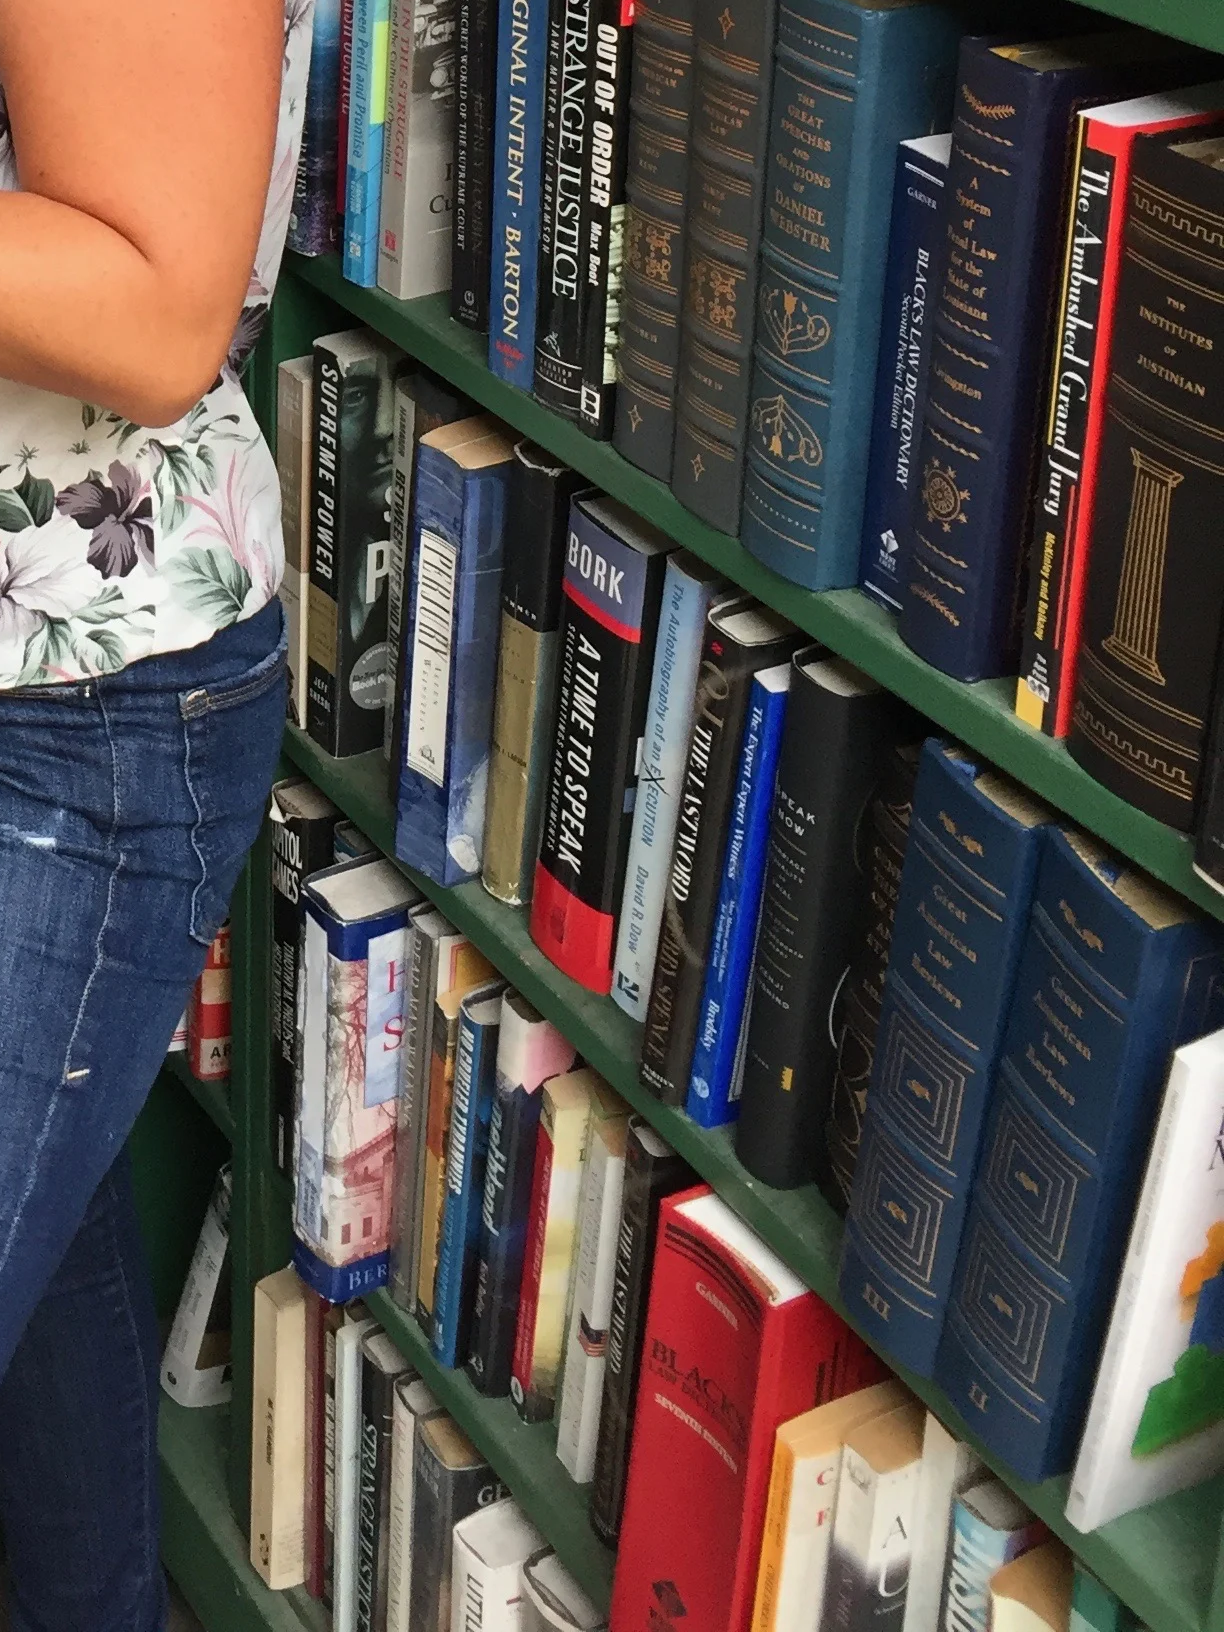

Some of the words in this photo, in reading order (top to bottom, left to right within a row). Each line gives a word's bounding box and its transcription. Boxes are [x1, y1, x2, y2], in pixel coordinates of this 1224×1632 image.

[596, 23, 619, 75] OUT
[594, 76, 616, 116] OF
[506, 94, 525, 207] INTENT
[589, 121, 613, 208] ORDER
[1077, 165, 1111, 213] The
[552, 156, 583, 301] JUSTICE
[499, 224, 522, 340] BARTON
[910, 247, 930, 327] BLACK'S
[1062, 223, 1103, 367] Ambushed
[906, 329, 923, 374] LAW
[319, 363, 339, 487] SUPREME
[895, 374, 920, 489] DICTIONARY
[1054, 370, 1087, 460] Grand
[1043, 455, 1078, 518] Jury
[316, 490, 336, 580] POWER
[568, 532, 625, 605] BORK
[579, 633, 599, 660] A
[575, 658, 600, 737] TIME
[572, 740, 590, 781] TO
[558, 782, 588, 874] SPEAK
